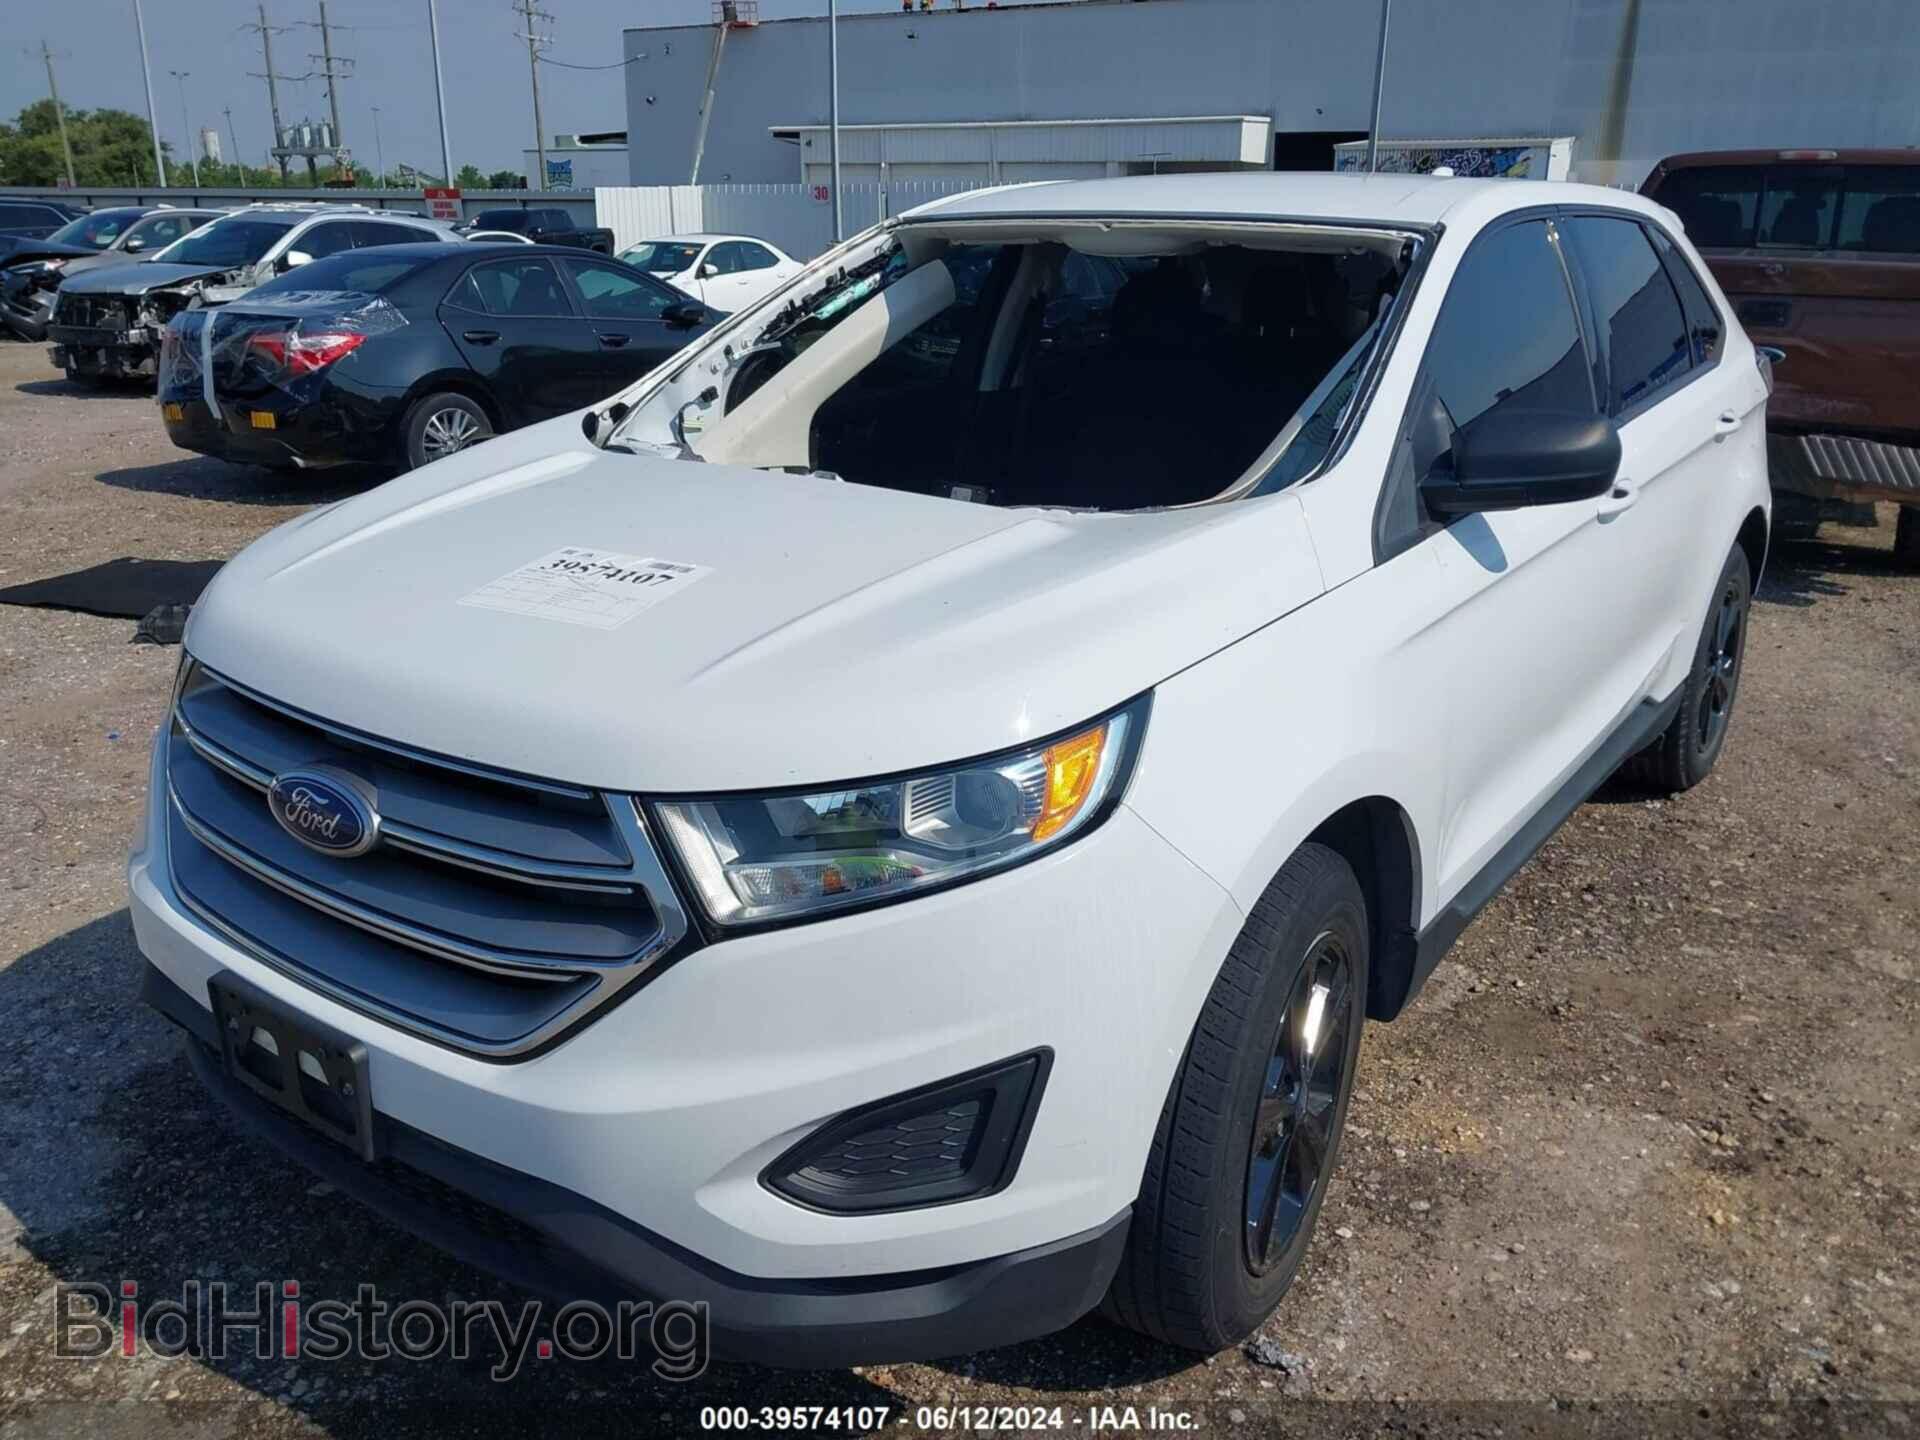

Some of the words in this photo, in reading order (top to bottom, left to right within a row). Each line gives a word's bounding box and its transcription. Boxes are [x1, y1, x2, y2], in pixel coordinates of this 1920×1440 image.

[814, 186, 828, 200] 30
[539, 559, 675, 587] 39574107
[285, 787, 341, 839] Ford
